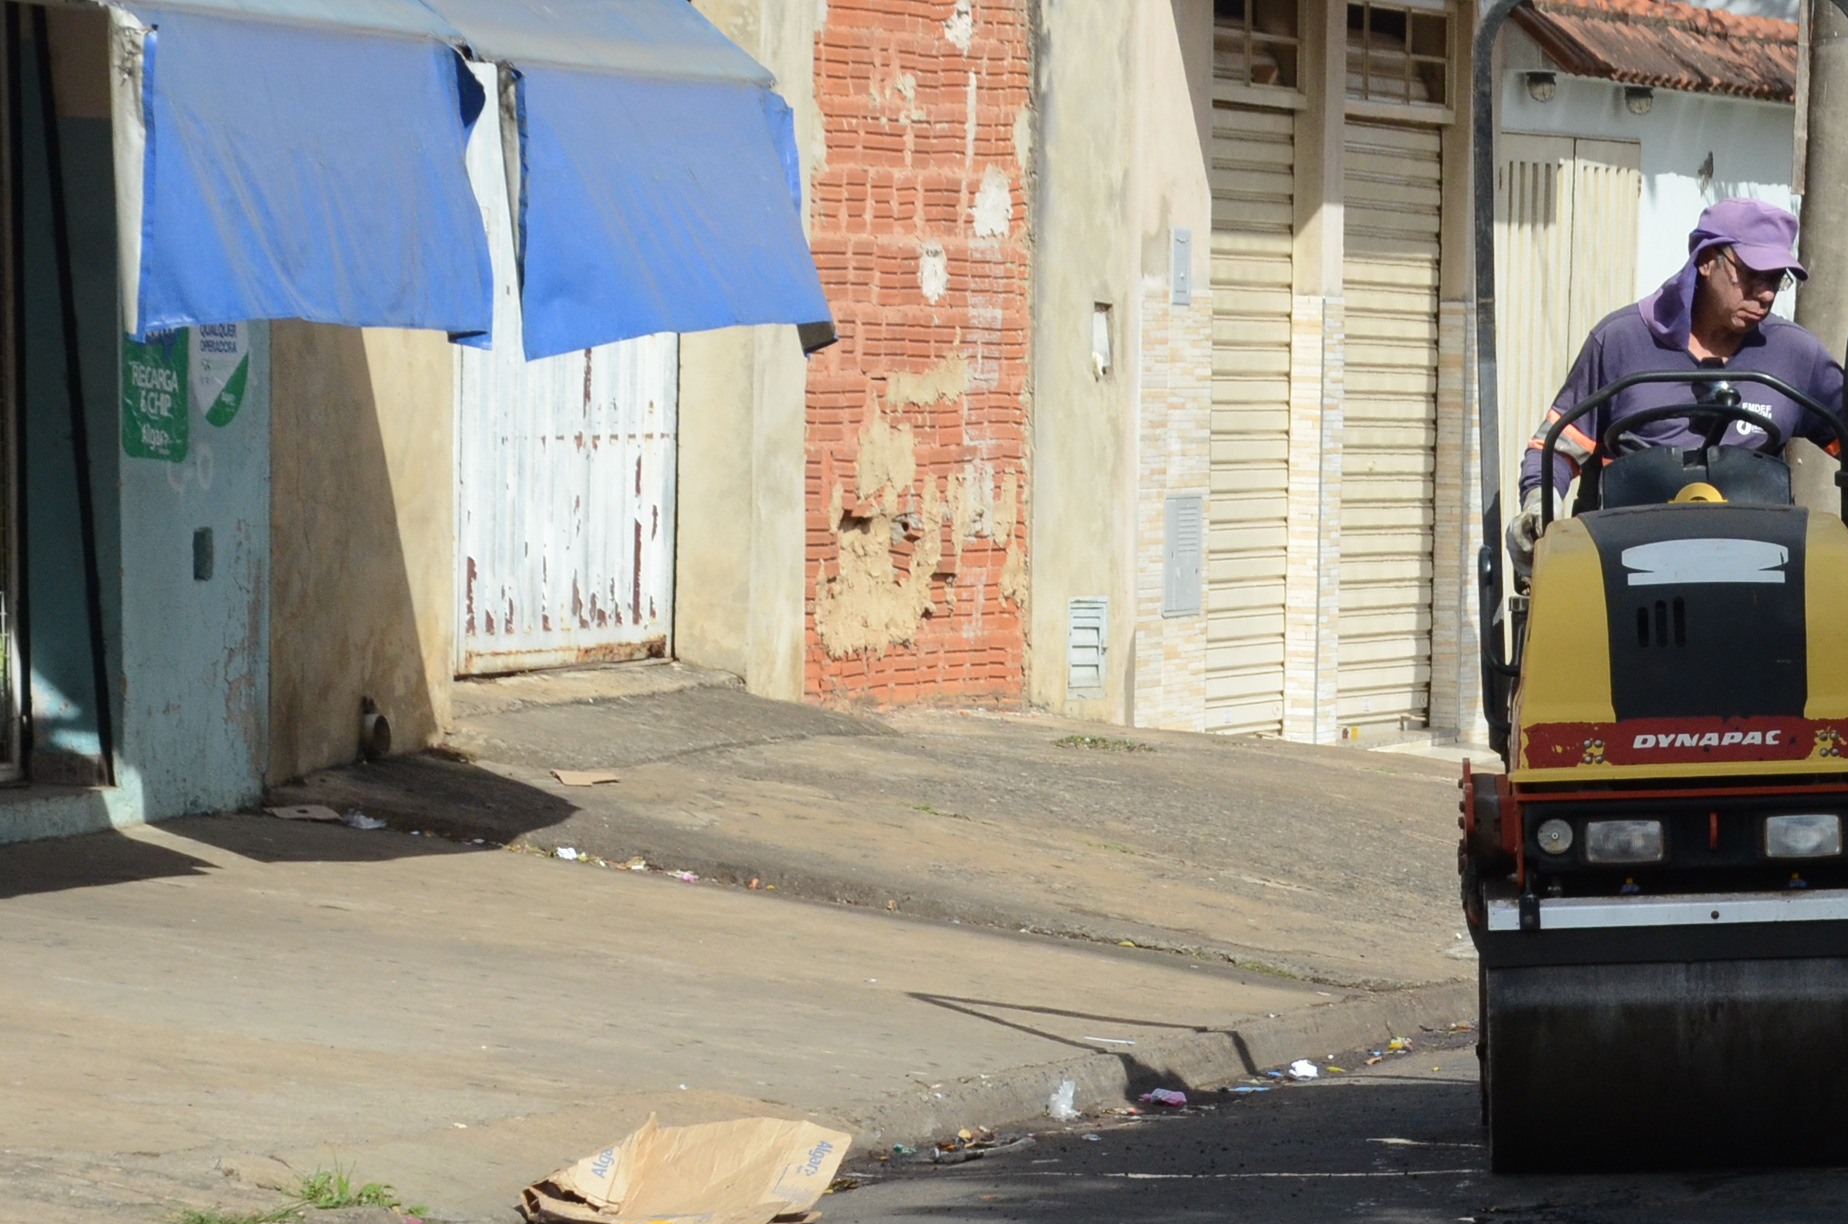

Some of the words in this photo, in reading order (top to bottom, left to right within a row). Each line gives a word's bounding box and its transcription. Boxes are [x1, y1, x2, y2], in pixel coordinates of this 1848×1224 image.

[200, 340, 237, 353] OPERADORA
[131, 365, 179, 393] RECARGA
[147, 391, 172, 416] CHIP
[1633, 730, 1781, 748] DYNAPAC
[808, 1140, 834, 1171] Algar
